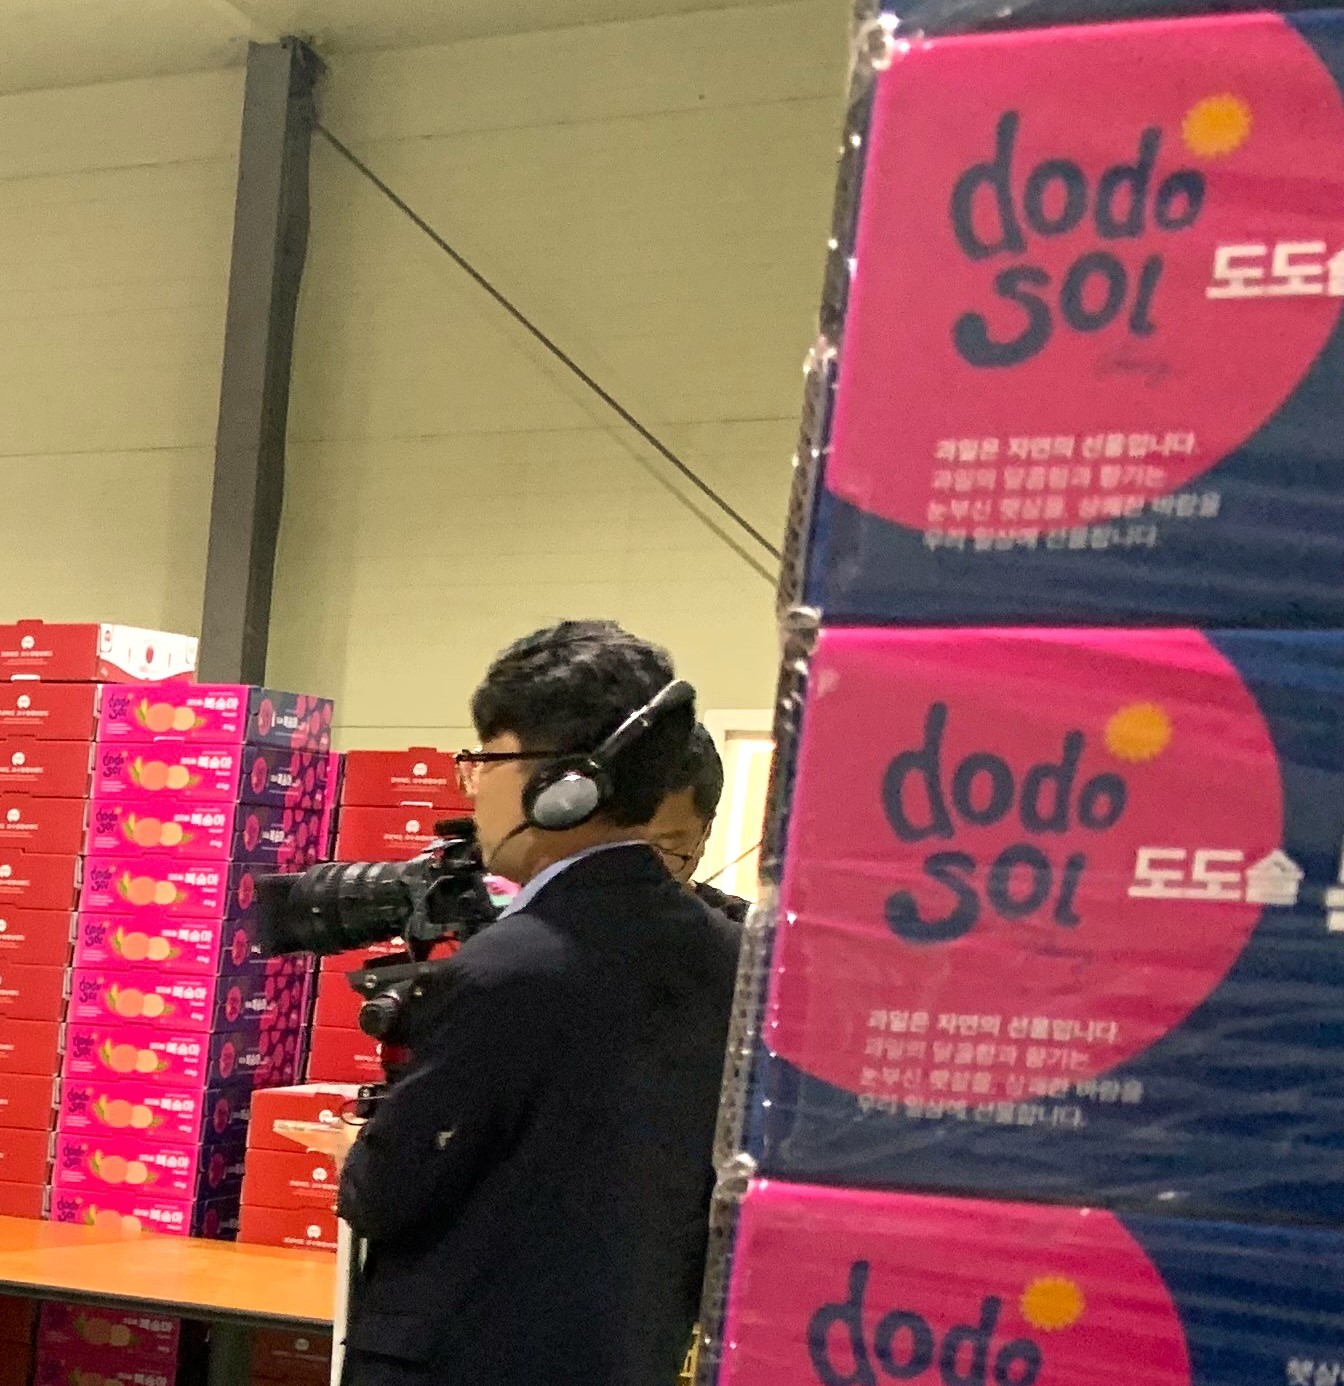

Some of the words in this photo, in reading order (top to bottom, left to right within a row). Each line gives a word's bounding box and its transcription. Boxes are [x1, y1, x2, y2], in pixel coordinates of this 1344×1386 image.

[949, 110, 1206, 262] dodo
[952, 251, 1164, 368] sol
[882, 702, 1127, 842] dodo
[885, 844, 1086, 945] sol
[1128, 847, 1303, 904] 도도솔
